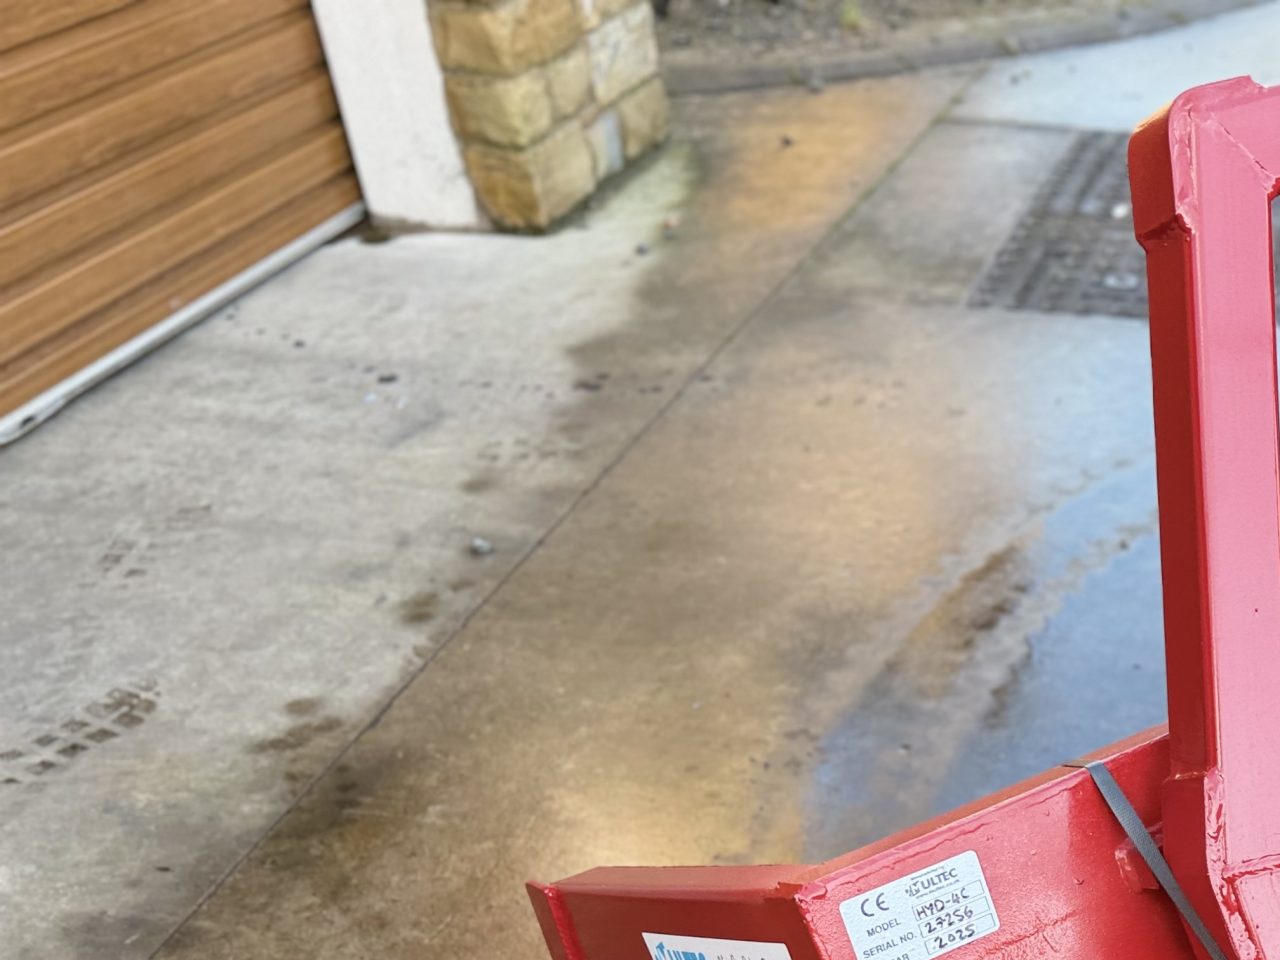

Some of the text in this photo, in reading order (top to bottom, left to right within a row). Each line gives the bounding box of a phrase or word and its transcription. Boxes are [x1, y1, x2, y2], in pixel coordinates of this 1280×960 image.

[860, 892, 890, 917] CE
[866, 918, 902, 938] MODEL
[863, 938, 898, 959] SERIAL
[899, 931, 917, 944] NO.
